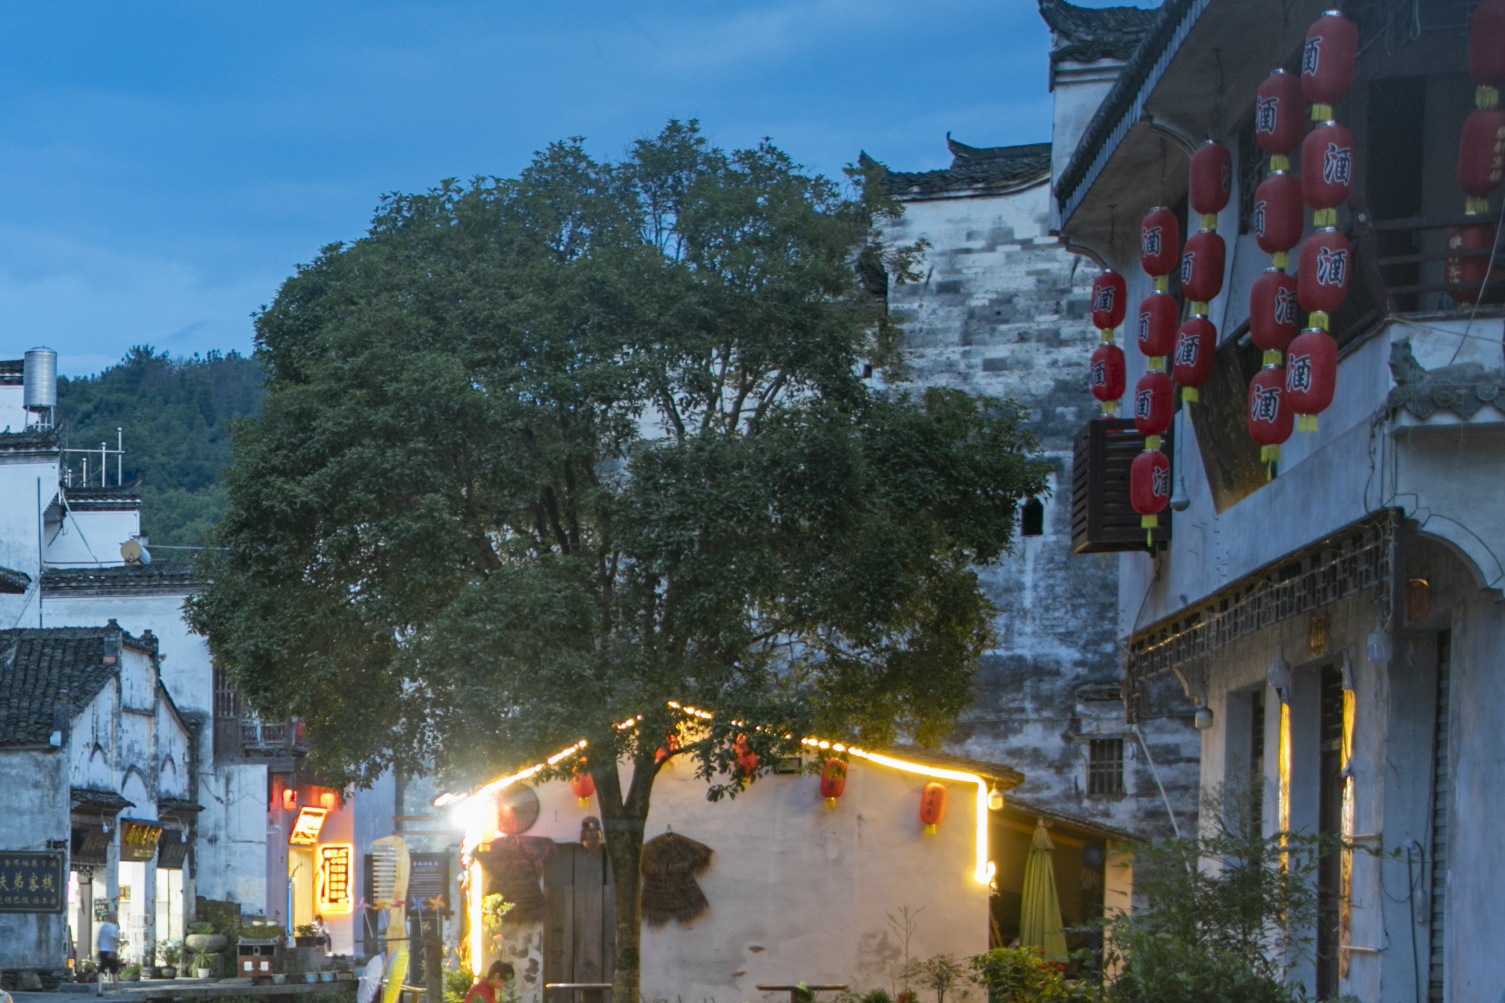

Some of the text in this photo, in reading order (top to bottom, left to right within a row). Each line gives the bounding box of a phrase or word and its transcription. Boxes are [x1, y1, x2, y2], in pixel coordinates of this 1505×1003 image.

[1256, 95, 1279, 134] 酒
[1324, 143, 1351, 186] 酒
[1141, 226, 1162, 257] 酒
[1317, 247, 1349, 287] 酒
[1093, 286, 1115, 312] 酒
[1176, 333, 1201, 367] 酒
[1286, 354, 1313, 393] 酒
[1135, 389, 1152, 419] 酒
[1251, 384, 1282, 423] 酒
